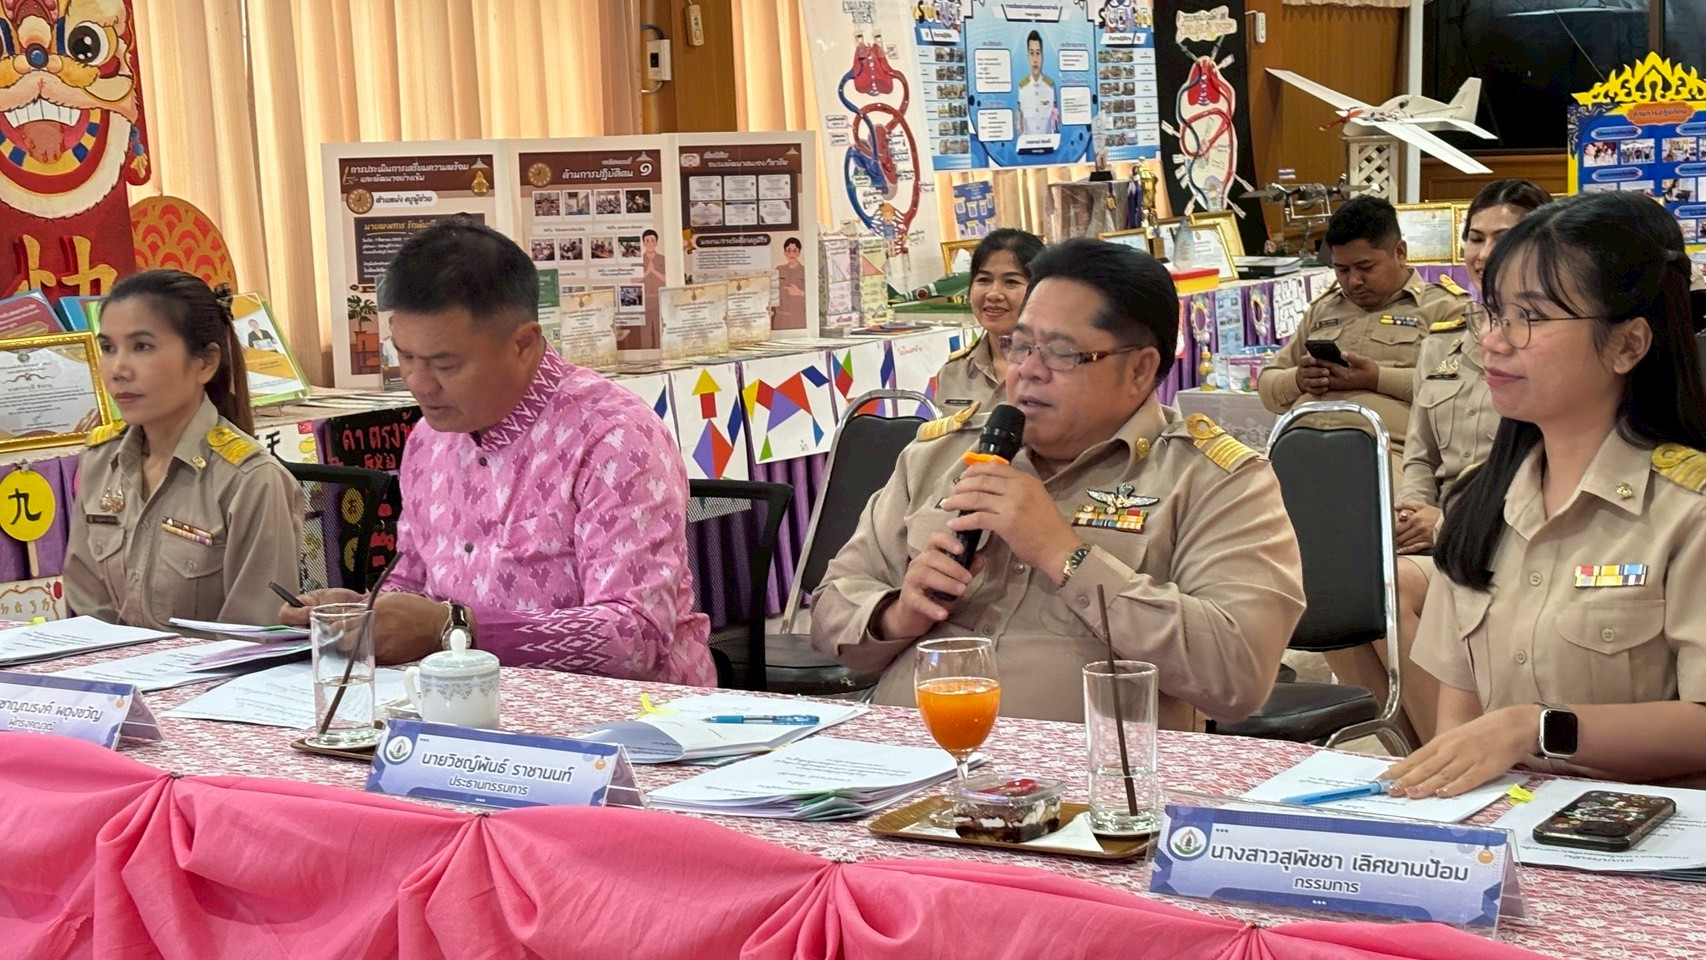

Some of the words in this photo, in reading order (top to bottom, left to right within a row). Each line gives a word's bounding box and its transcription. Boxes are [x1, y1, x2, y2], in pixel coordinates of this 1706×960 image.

[8, 488, 42, 525] 九
[55, 705, 103, 722] ผดุงขวัญ
[9, 716, 56, 733] ผู้ทรงคุณวุฒิ
[422, 752, 510, 774] นายวิชญ์พันธ์
[511, 764, 575, 782] ราชานนท์
[449, 775, 528, 795] ประธานกรรมการ
[1211, 845, 1343, 871] นางสาวสุพิชชา
[1352, 854, 1469, 881] เลิศขามป้อม
[1294, 877, 1359, 893] กรรมการ
